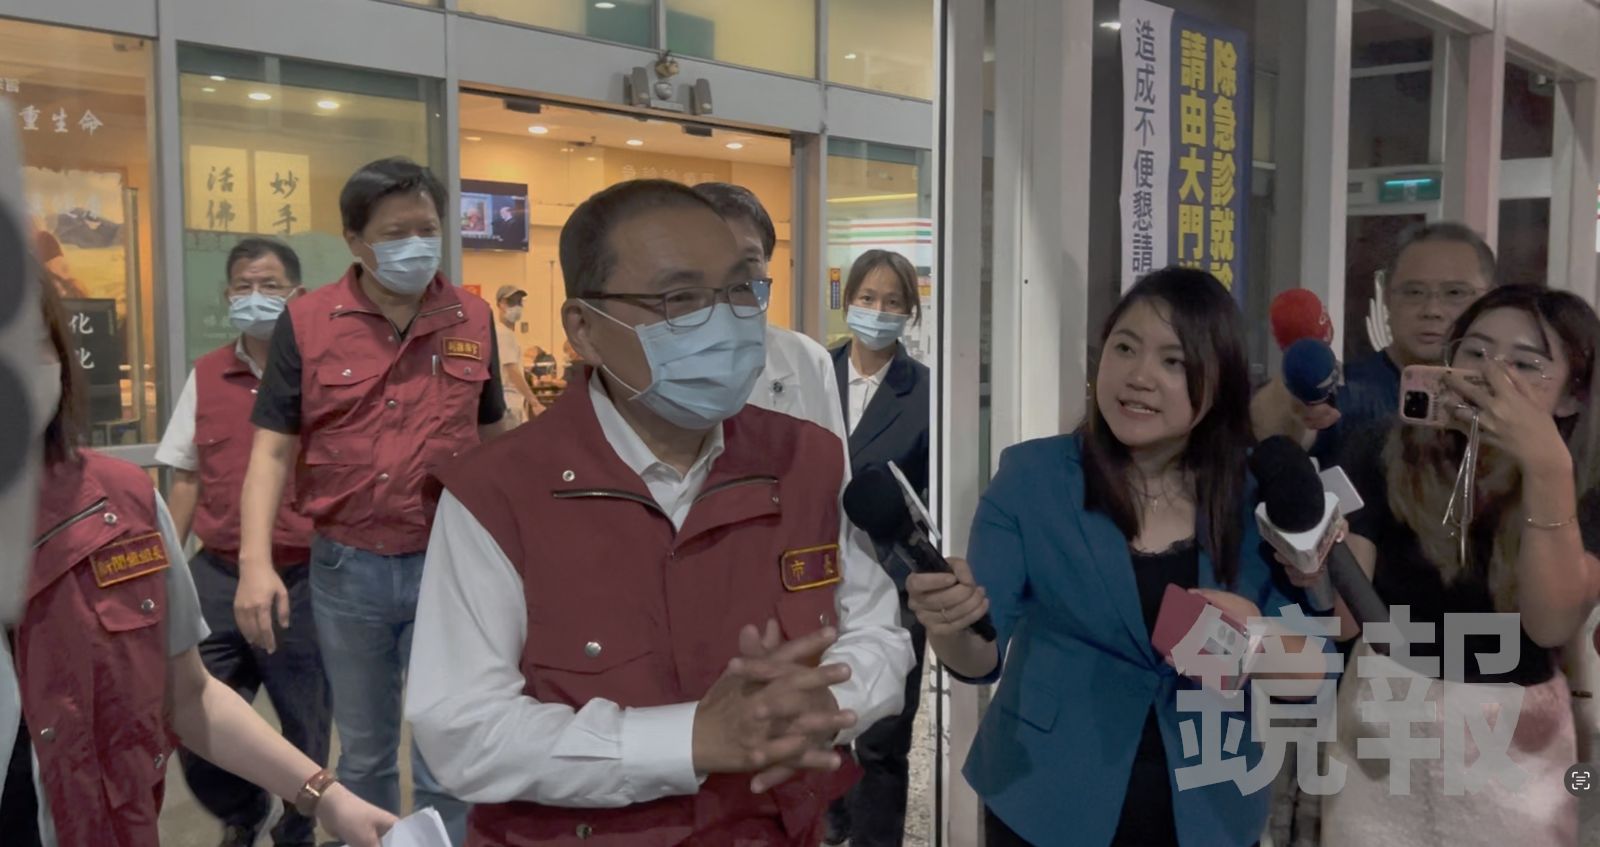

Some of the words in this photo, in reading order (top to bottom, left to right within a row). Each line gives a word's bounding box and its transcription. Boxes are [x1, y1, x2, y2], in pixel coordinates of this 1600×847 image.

[206, 165, 236, 231] 活佛
[269, 168, 300, 235] 妙手
[1132, 18, 1157, 282] 造成不便懇請
[1178, 29, 1207, 269] 請由大門
